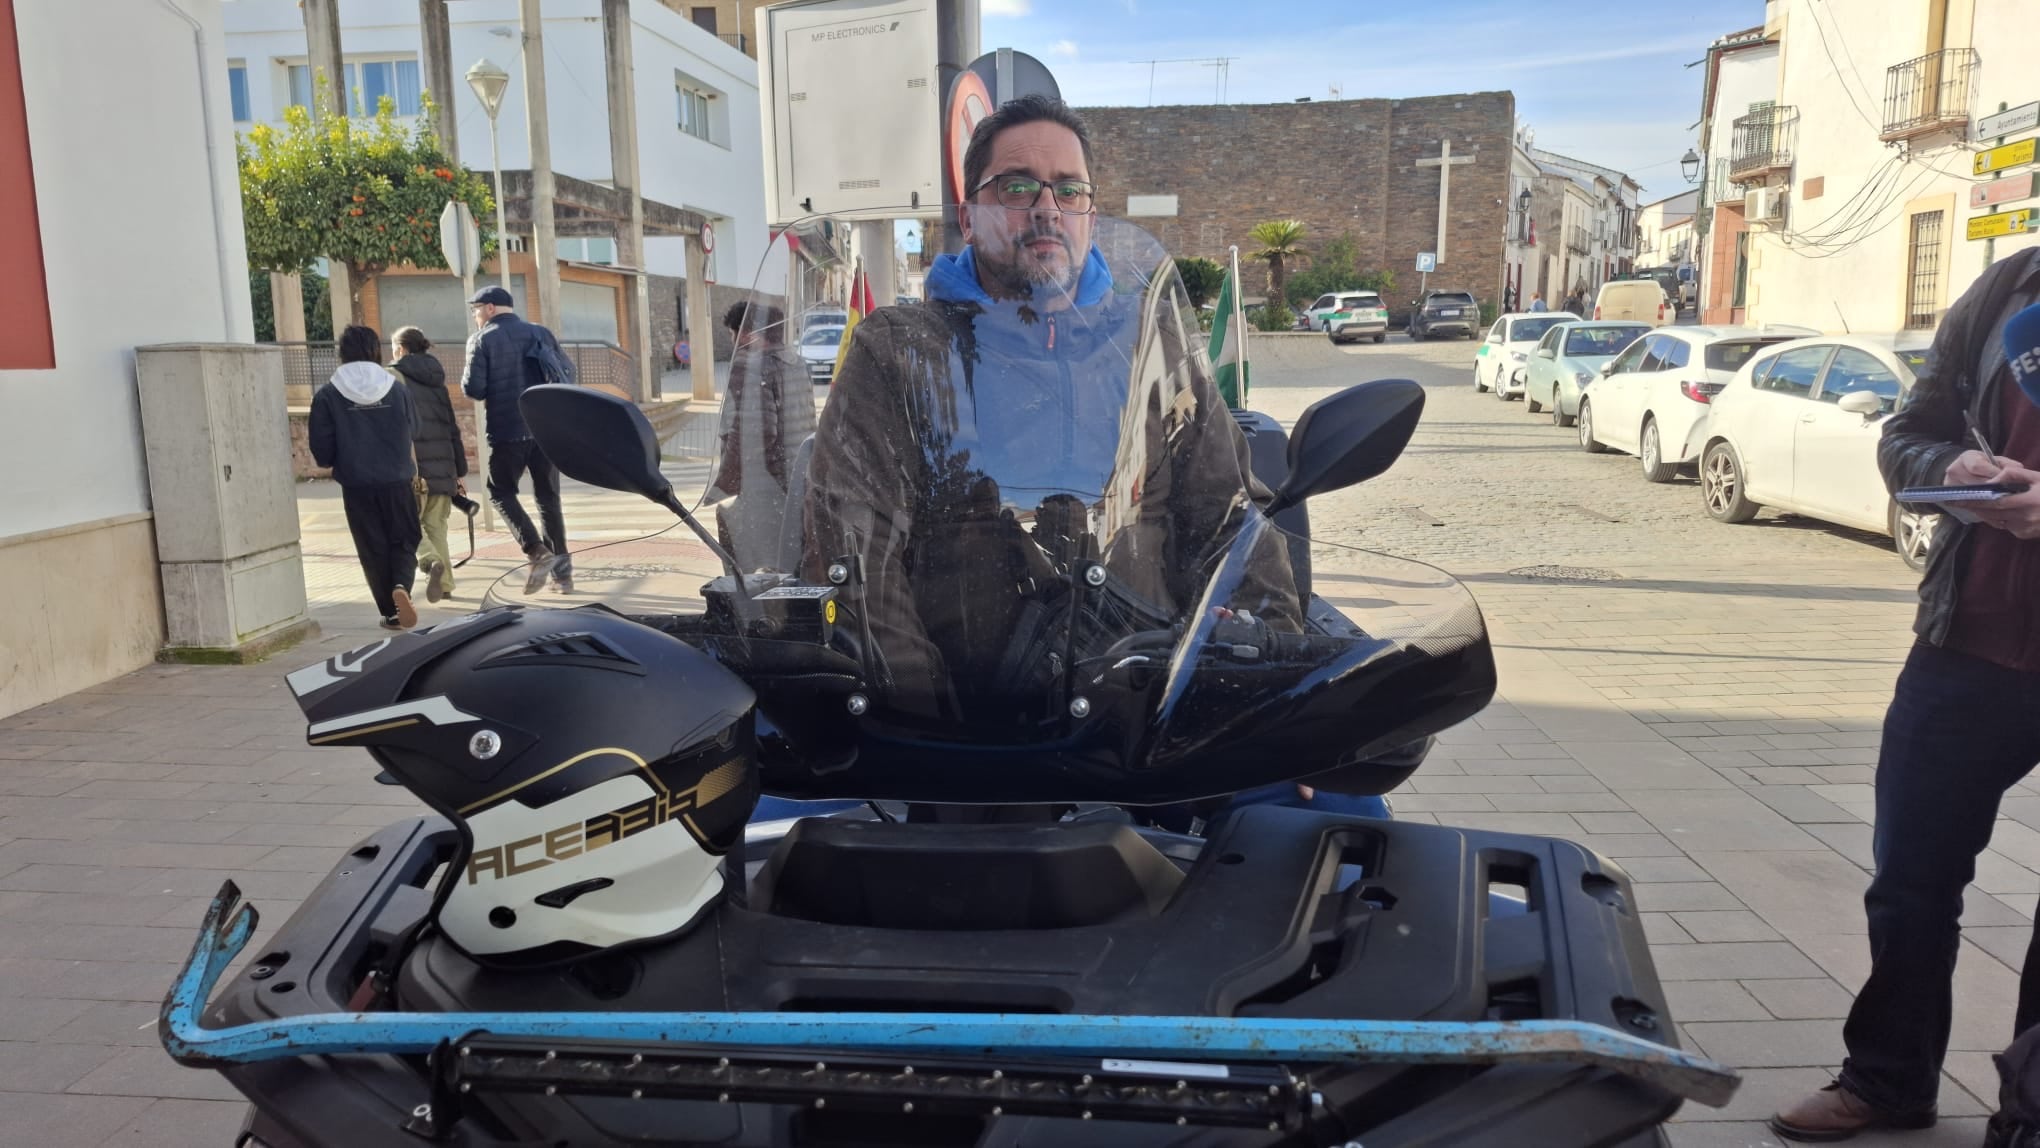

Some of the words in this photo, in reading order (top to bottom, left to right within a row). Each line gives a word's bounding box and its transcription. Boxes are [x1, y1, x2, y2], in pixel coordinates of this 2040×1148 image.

[811, 32, 826, 42] MP
[827, 24, 886, 40] ELECTRONICS
[1997, 112, 2037, 130] Ayuntamiento
[1421, 255, 1432, 269] P
